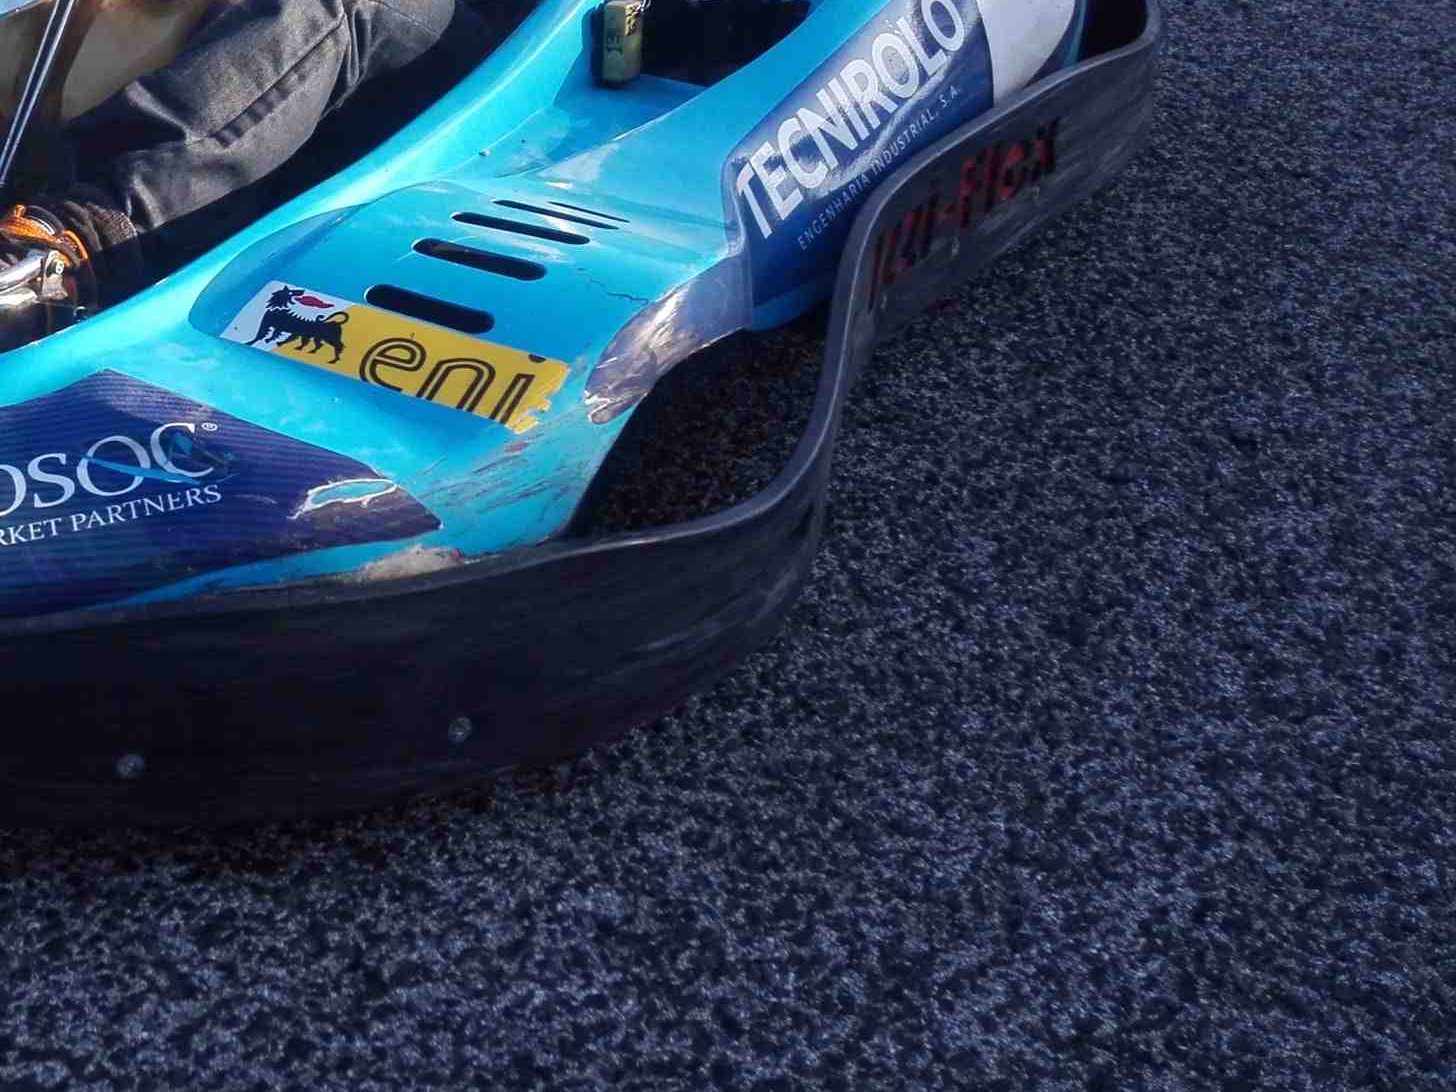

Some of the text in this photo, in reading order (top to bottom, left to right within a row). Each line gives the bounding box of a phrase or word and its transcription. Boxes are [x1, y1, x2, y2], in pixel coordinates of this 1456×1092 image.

[797, 175, 871, 251] ENGENHARIA
[359, 337, 547, 425] eni
[71, 483, 223, 534] PARTNERS
